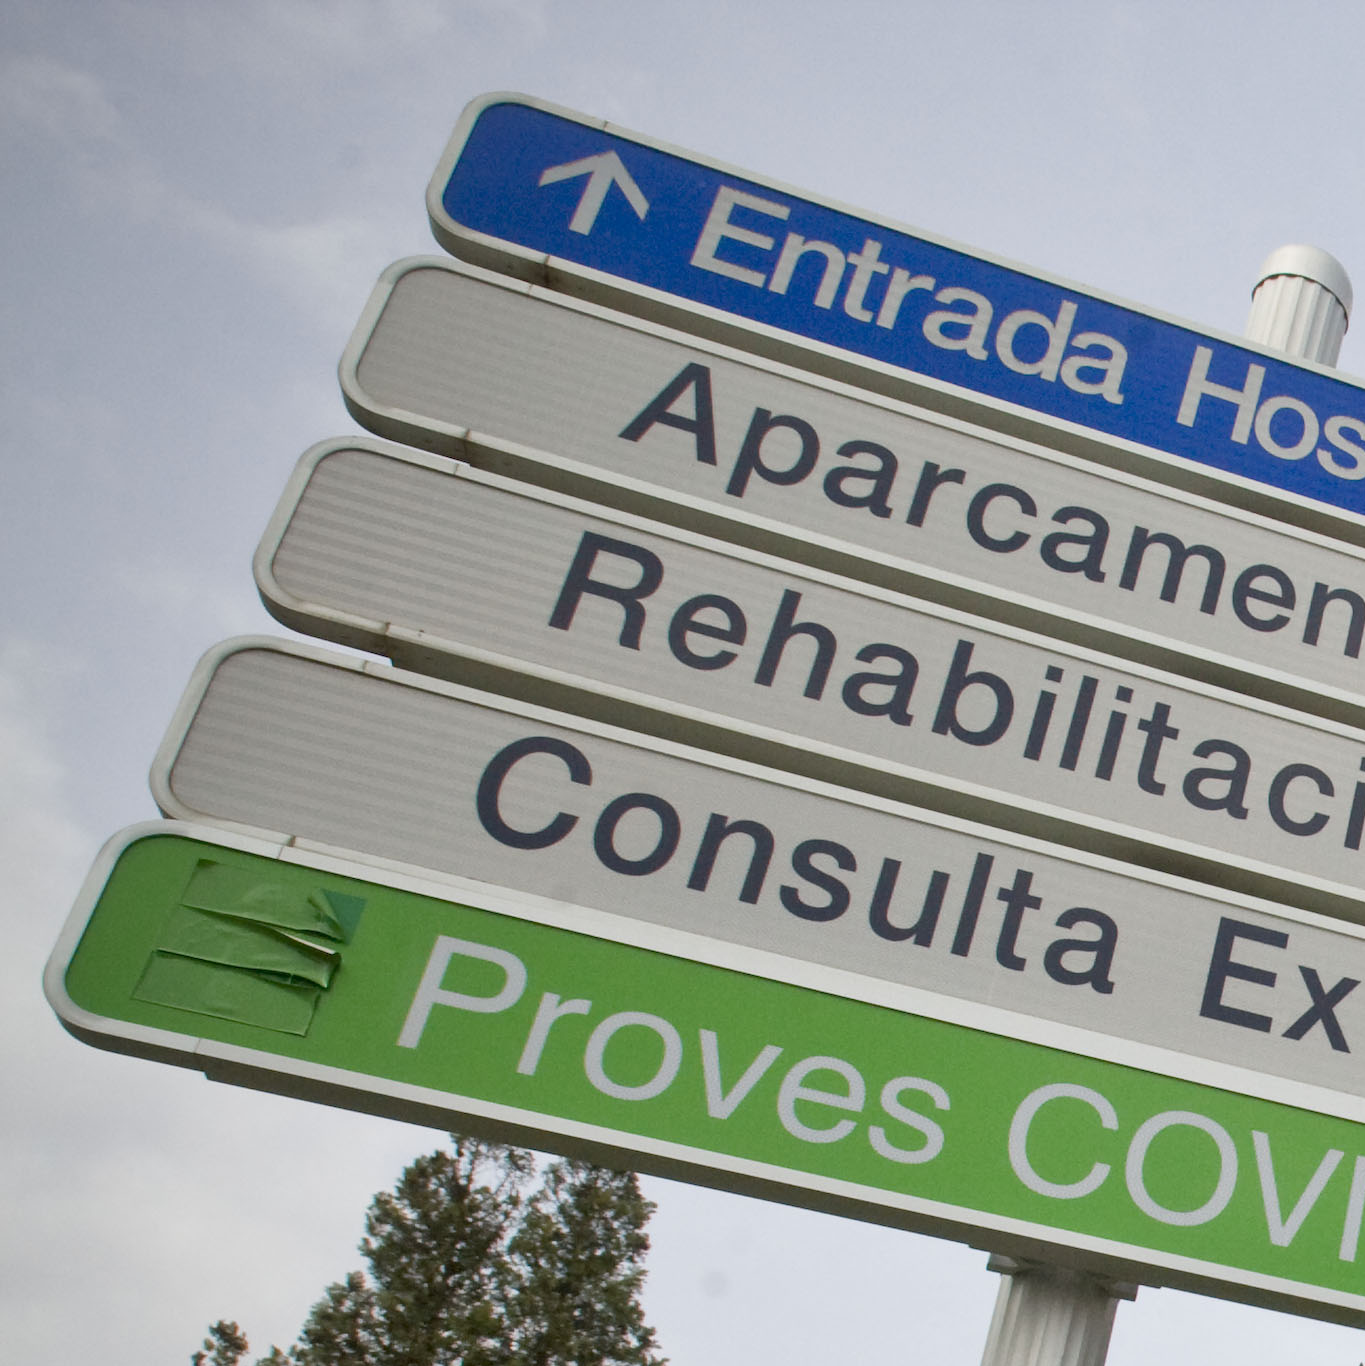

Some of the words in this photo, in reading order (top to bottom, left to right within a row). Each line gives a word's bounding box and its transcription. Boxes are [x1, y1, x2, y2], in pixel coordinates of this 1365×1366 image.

[690, 186, 1125, 404] Entrada
[476, 736, 1118, 994] Consulta
[397, 935, 951, 1164] Proves
